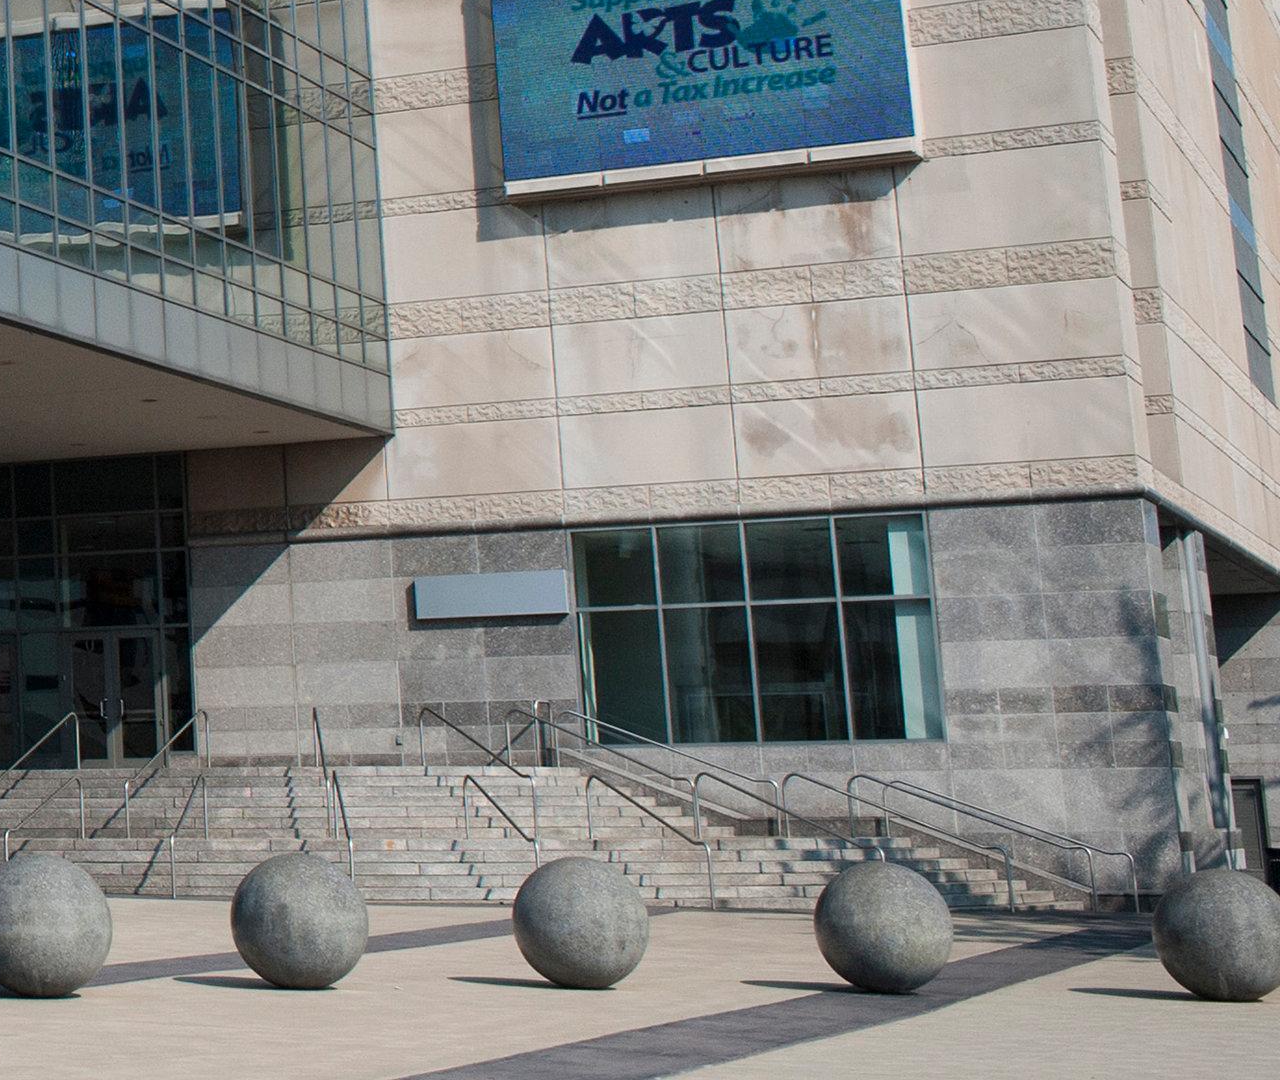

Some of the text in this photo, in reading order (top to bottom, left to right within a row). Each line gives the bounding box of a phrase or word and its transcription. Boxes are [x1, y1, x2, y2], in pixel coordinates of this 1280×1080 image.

[656, 34, 834, 78] & CULTURE
[577, 66, 836, 115] Not a Tax Increase
